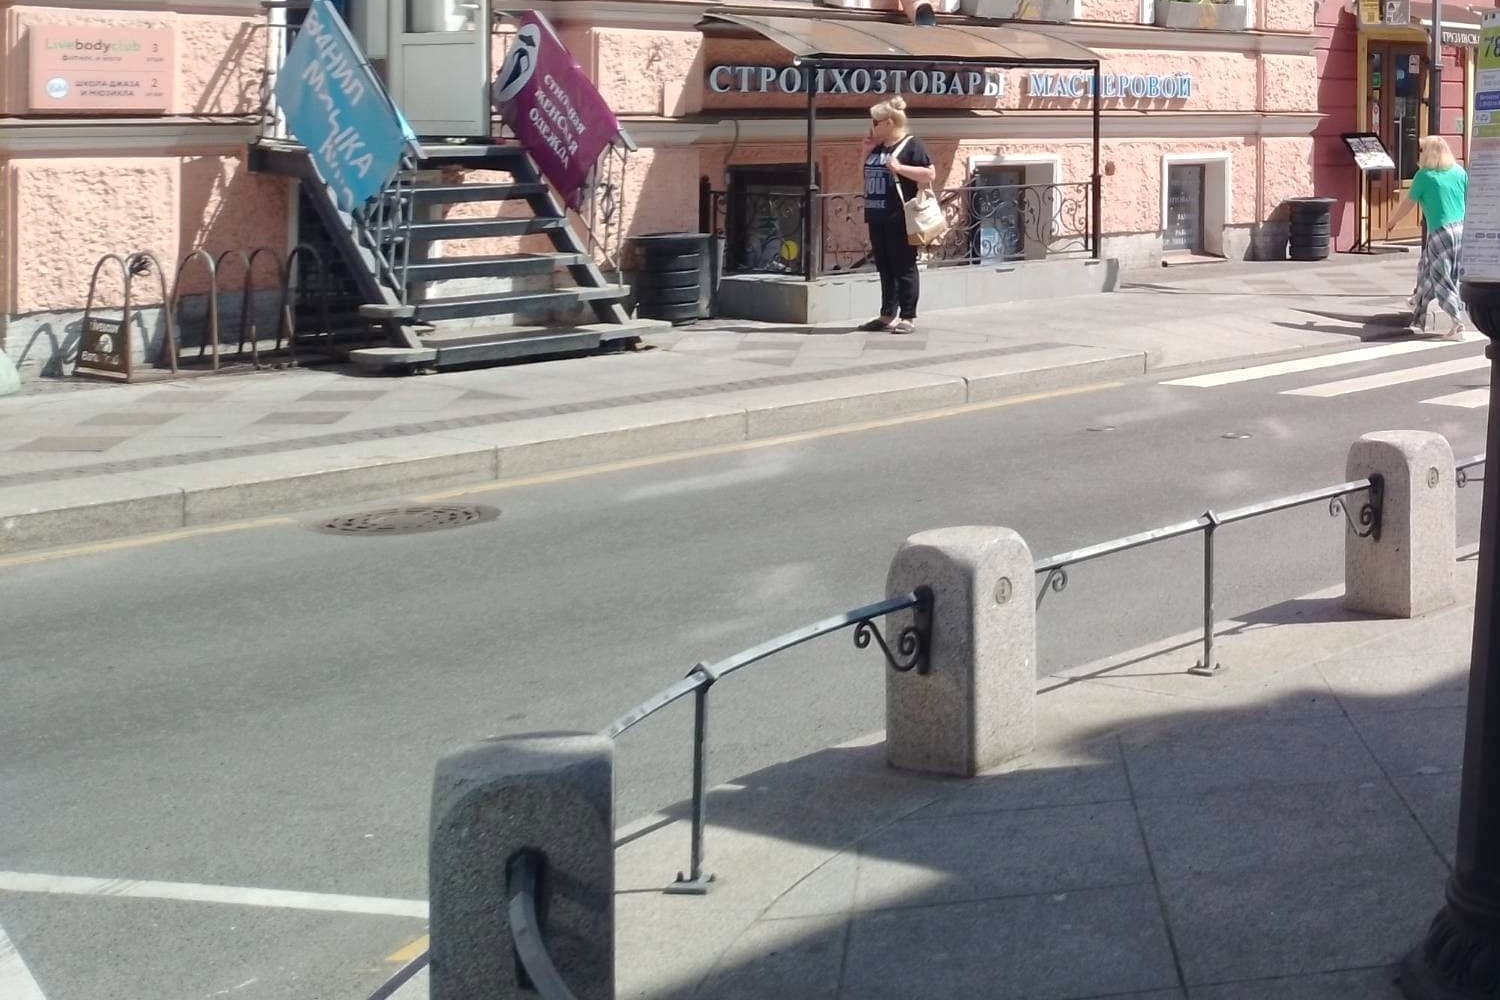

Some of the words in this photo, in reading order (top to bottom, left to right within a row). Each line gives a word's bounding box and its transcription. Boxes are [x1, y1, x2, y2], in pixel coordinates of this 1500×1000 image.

[152, 43, 158, 53] 3
[152, 78, 158, 88] 2
[1029, 72, 1192, 99] МАСТЕРОВОЙ
